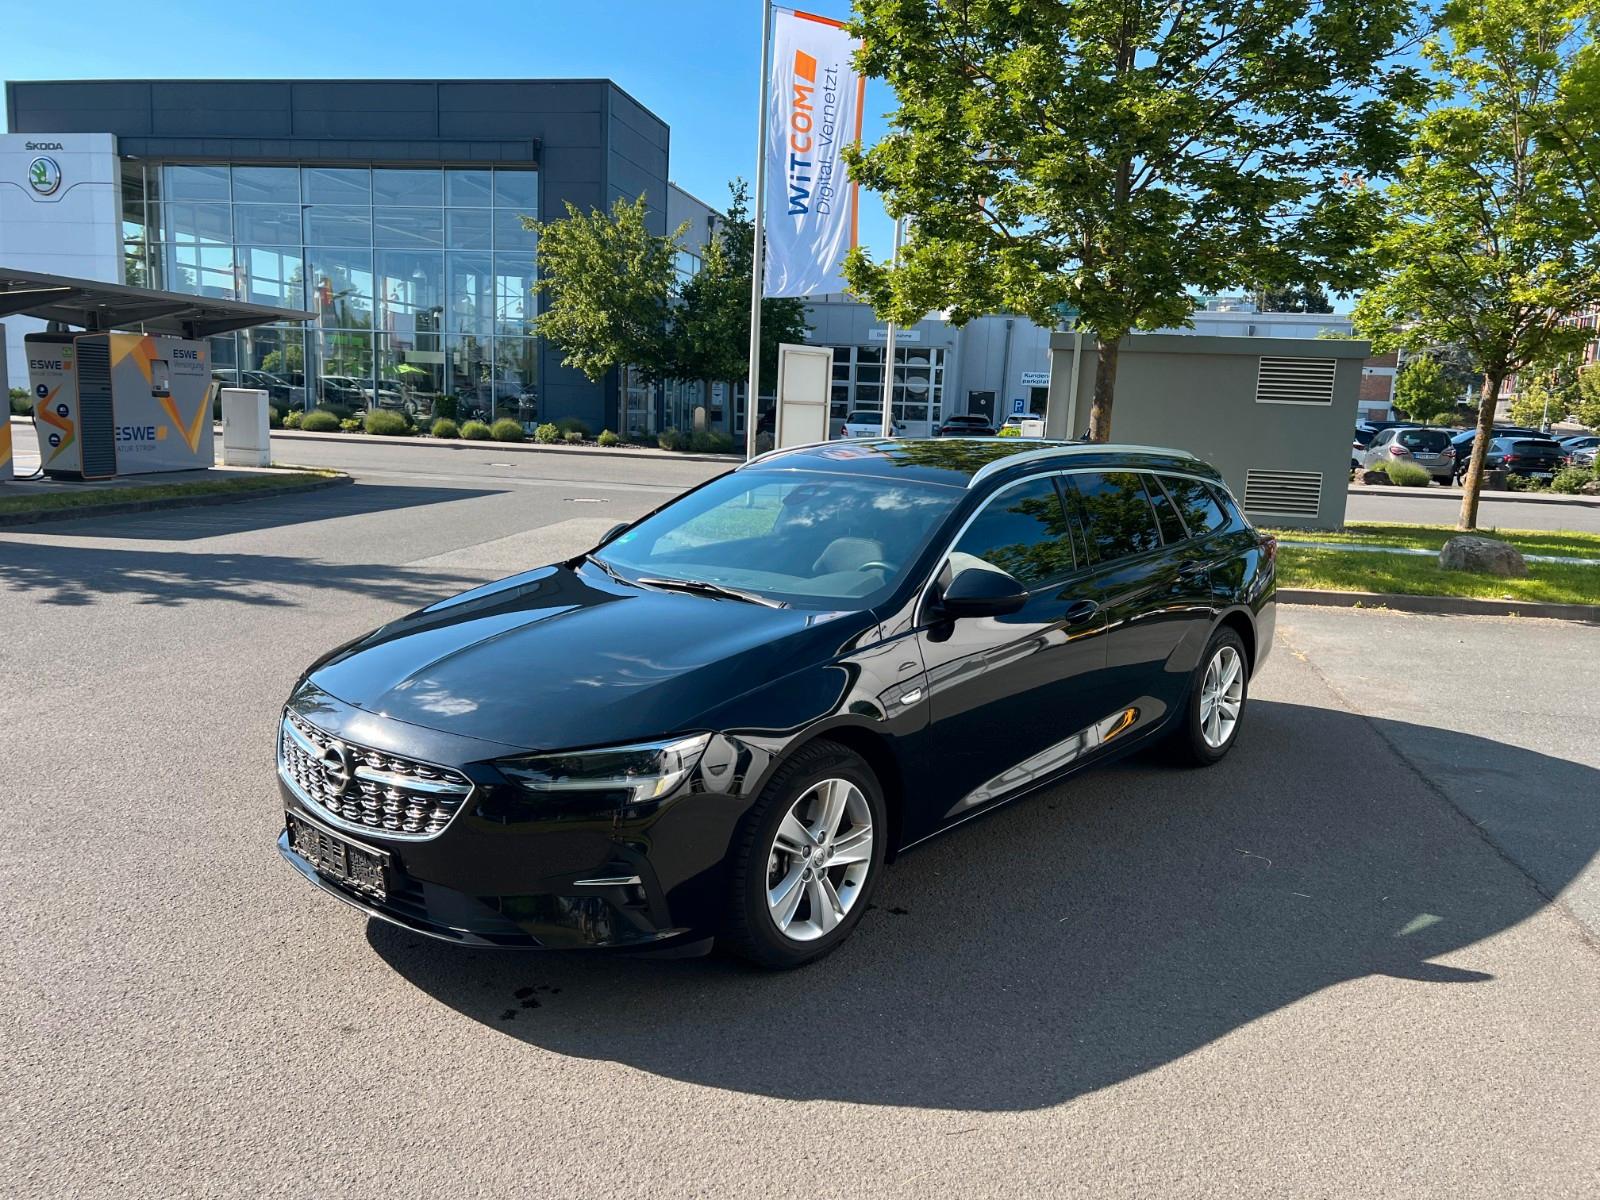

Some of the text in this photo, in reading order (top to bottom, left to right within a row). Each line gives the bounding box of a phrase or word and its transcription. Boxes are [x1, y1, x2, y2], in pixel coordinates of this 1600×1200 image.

[816, 63, 839, 215] Digital. Vernetzt.
[25, 141, 64, 151] ŠKODA
[173, 349, 198, 360] ESWE
[30, 359, 62, 370] ESWE
[115, 426, 155, 441] ESWE
